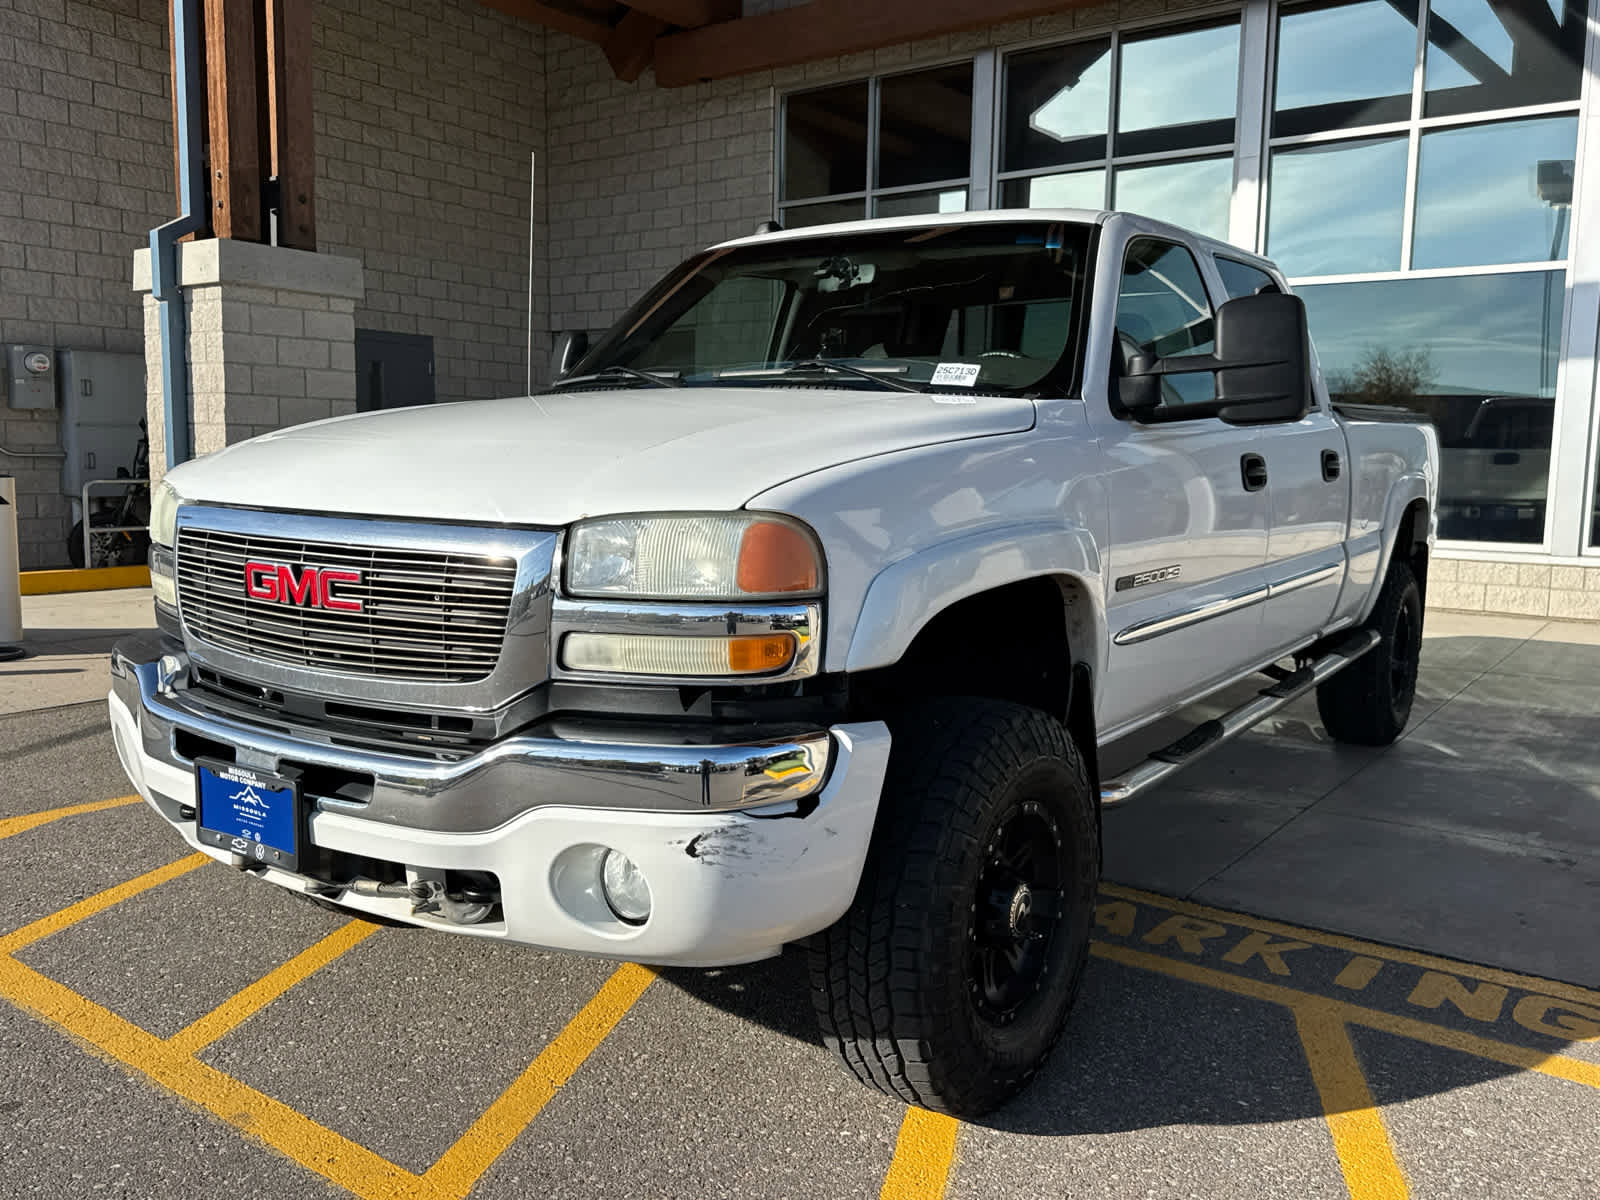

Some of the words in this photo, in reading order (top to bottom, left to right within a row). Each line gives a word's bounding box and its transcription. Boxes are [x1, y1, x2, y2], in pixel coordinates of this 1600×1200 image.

[245, 560, 363, 612] GMC
[219, 771, 239, 783] MOTOR
[239, 776, 267, 790] COMPANY
[228, 767, 257, 780] MISSOULA
[233, 803, 268, 818] MISSOULA
[1094, 901, 1600, 1043] ARKING
